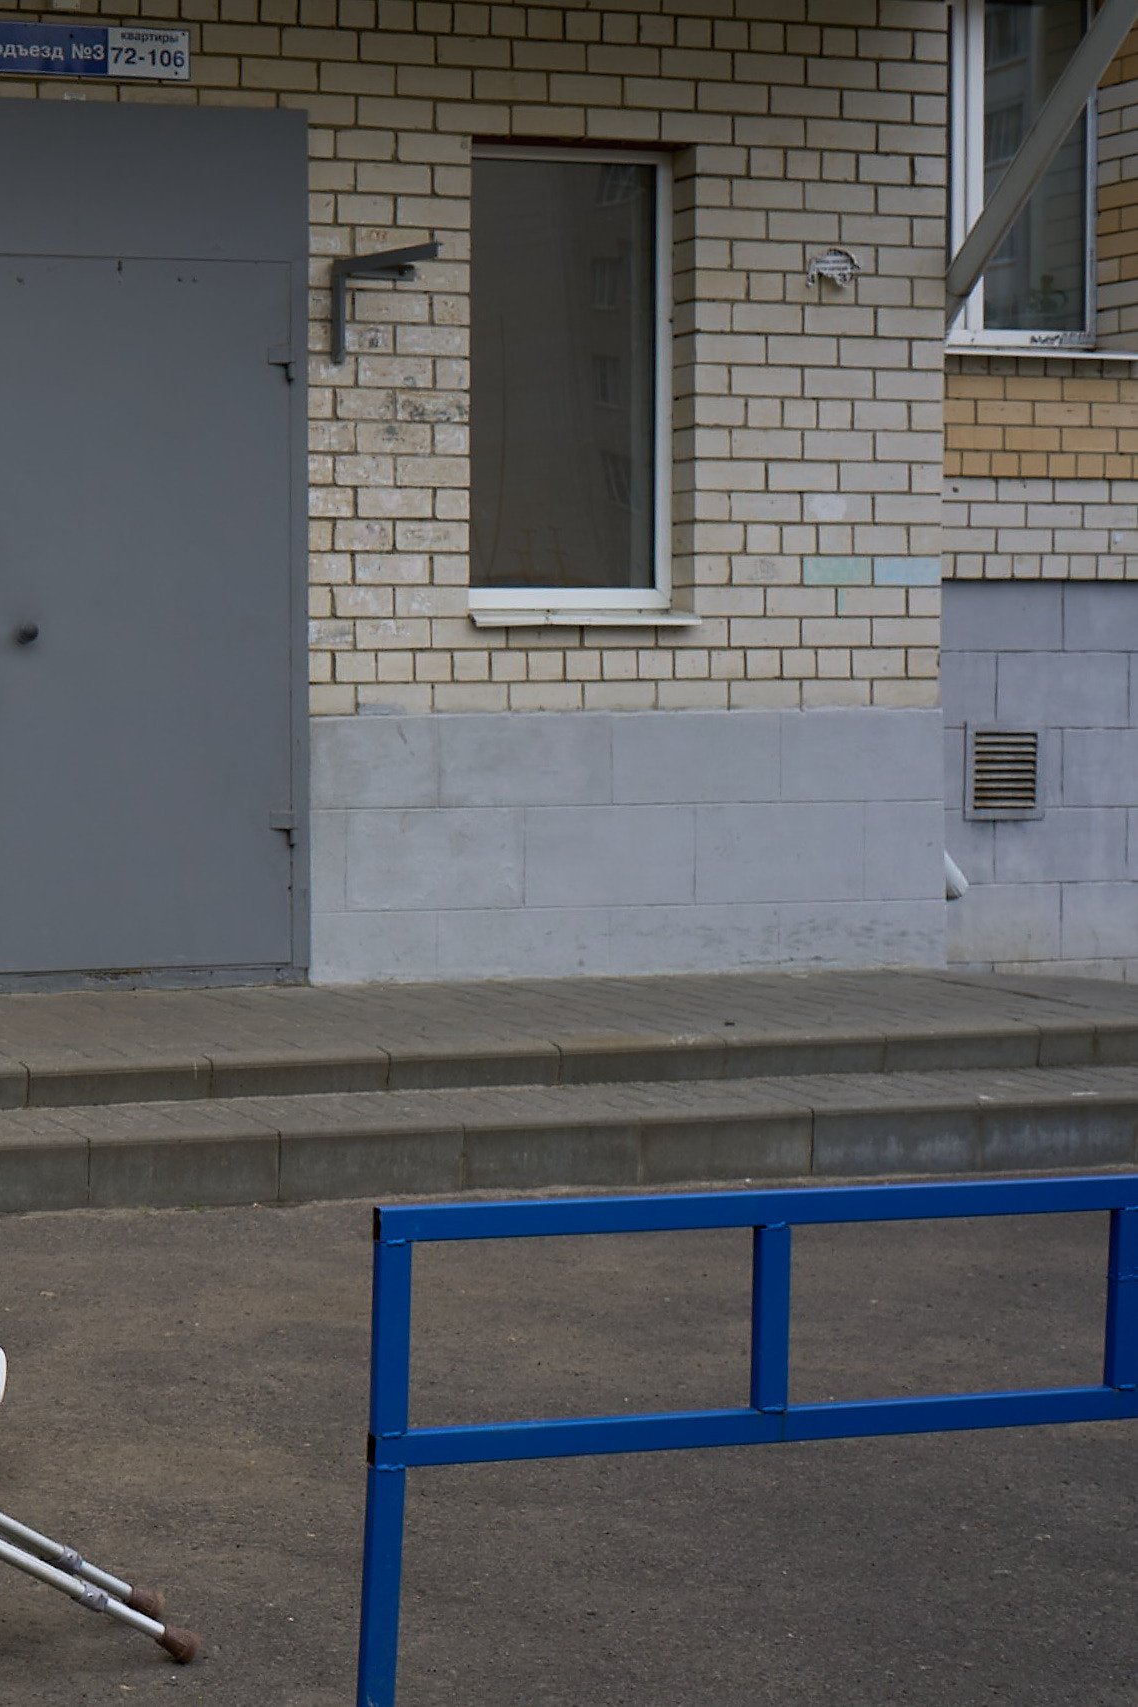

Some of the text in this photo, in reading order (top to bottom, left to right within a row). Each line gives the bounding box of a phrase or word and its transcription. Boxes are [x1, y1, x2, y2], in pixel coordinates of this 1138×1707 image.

[121, 32, 179, 43] квартиры
[71, 43, 105, 60] №3
[111, 47, 185, 67] 72-106
